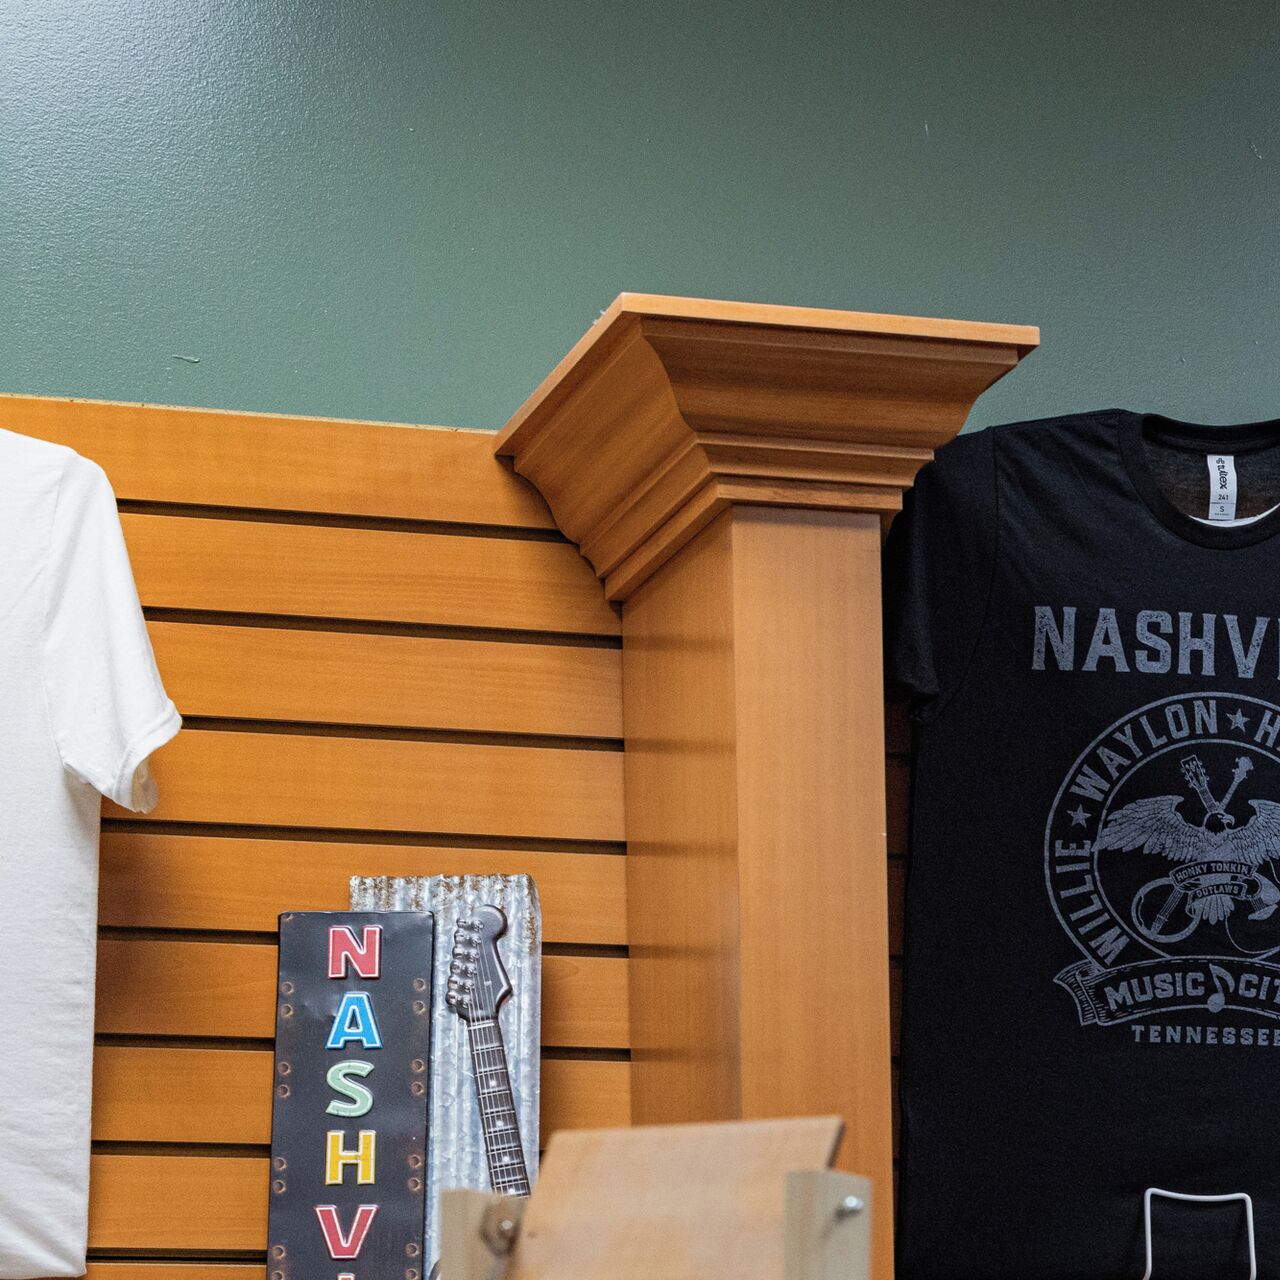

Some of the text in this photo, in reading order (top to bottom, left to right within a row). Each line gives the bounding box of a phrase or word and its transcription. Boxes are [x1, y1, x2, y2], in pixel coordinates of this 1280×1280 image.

[1070, 699, 1217, 802] WAYLON
[1055, 839, 1131, 966] WILLIE
[1104, 972, 1204, 1011] MUSIC
